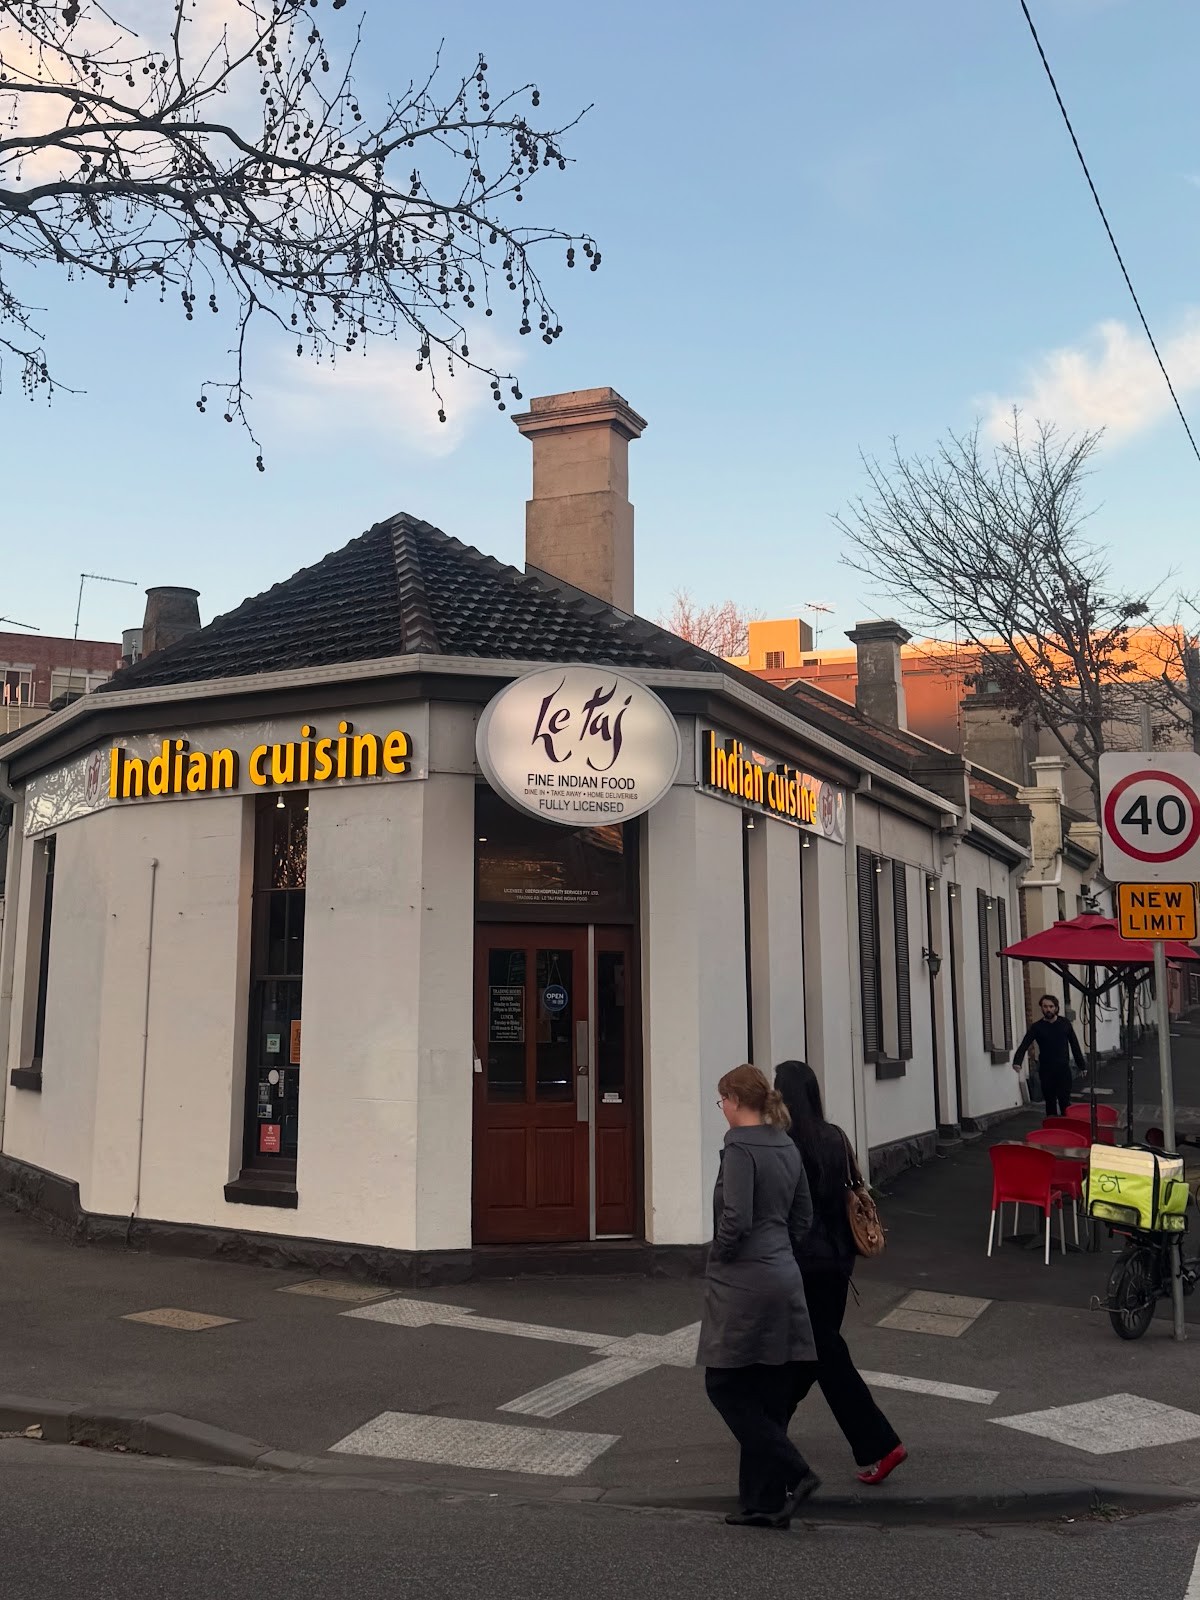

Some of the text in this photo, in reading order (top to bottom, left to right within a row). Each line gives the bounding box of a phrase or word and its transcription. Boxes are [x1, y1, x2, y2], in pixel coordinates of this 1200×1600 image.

[532, 675, 633, 772] Le Taj
[109, 738, 237, 799] Indian
[249, 720, 410, 787] cuisine
[527, 773, 636, 790] FINE INDIAN FOOD
[705, 729, 764, 804] Indian
[767, 763, 817, 825] cuisine
[550, 789, 565, 797] TAKE
[587, 791, 604, 799] HOME
[605, 792, 638, 800] DELIVERIES
[539, 798, 624, 813] FULLY LICENSED
[1120, 794, 1187, 836] 40
[1130, 891, 1182, 908] NEW
[1129, 914, 1186, 931] LIMIT
